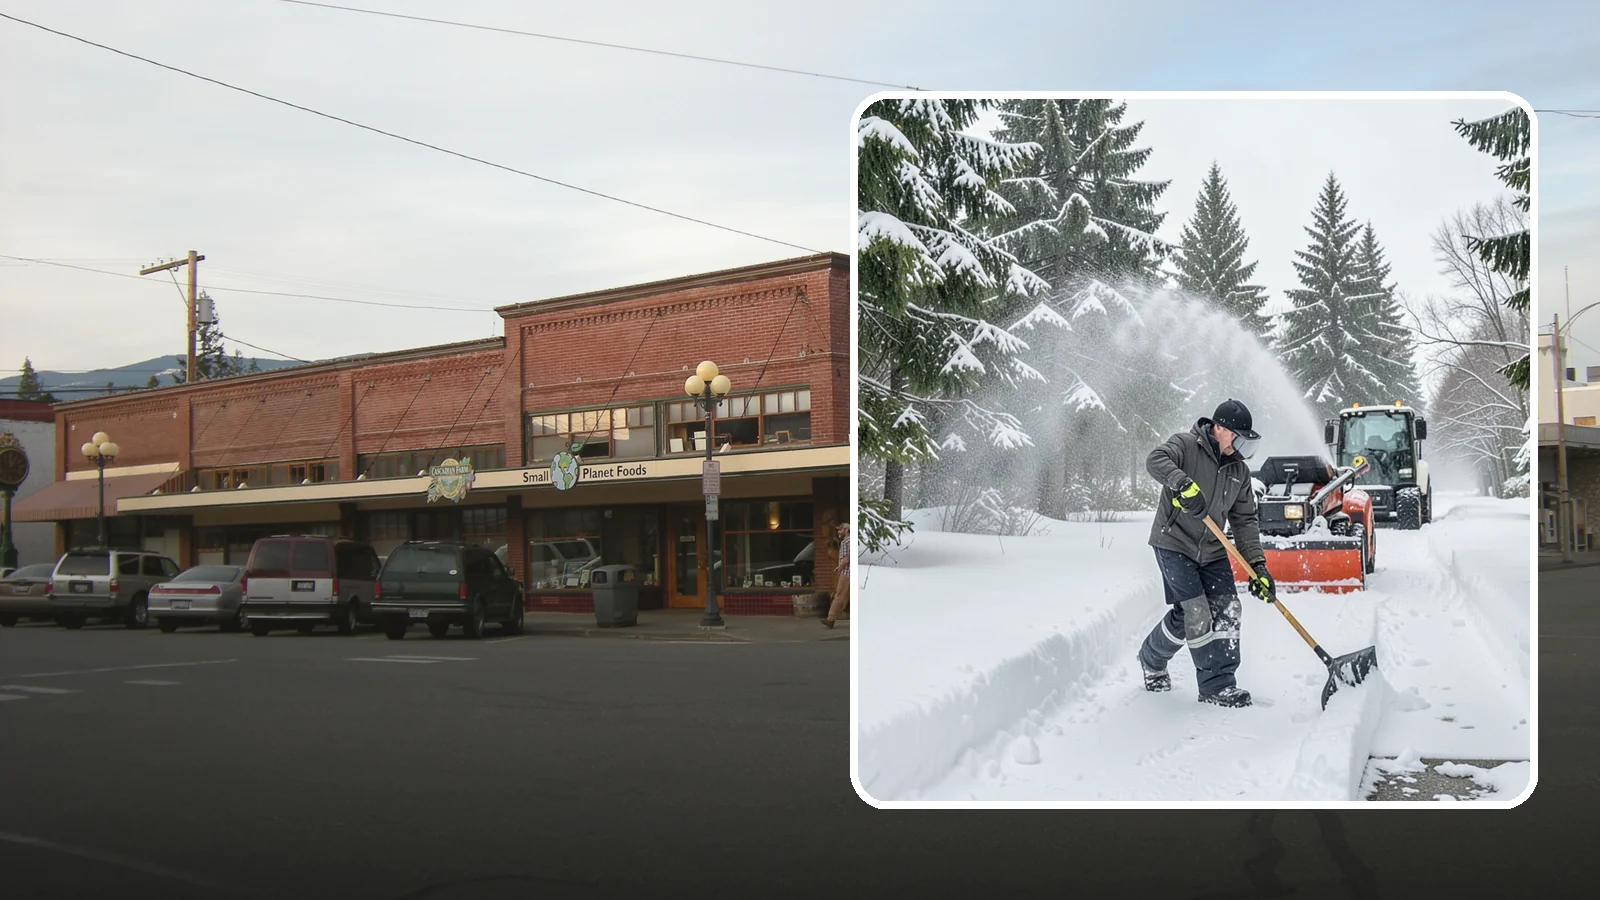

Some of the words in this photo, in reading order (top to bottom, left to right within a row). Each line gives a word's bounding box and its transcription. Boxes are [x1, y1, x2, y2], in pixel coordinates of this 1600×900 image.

[523, 470, 549, 483] Small
[583, 467, 614, 479] Planet
[617, 464, 647, 477] Foods
